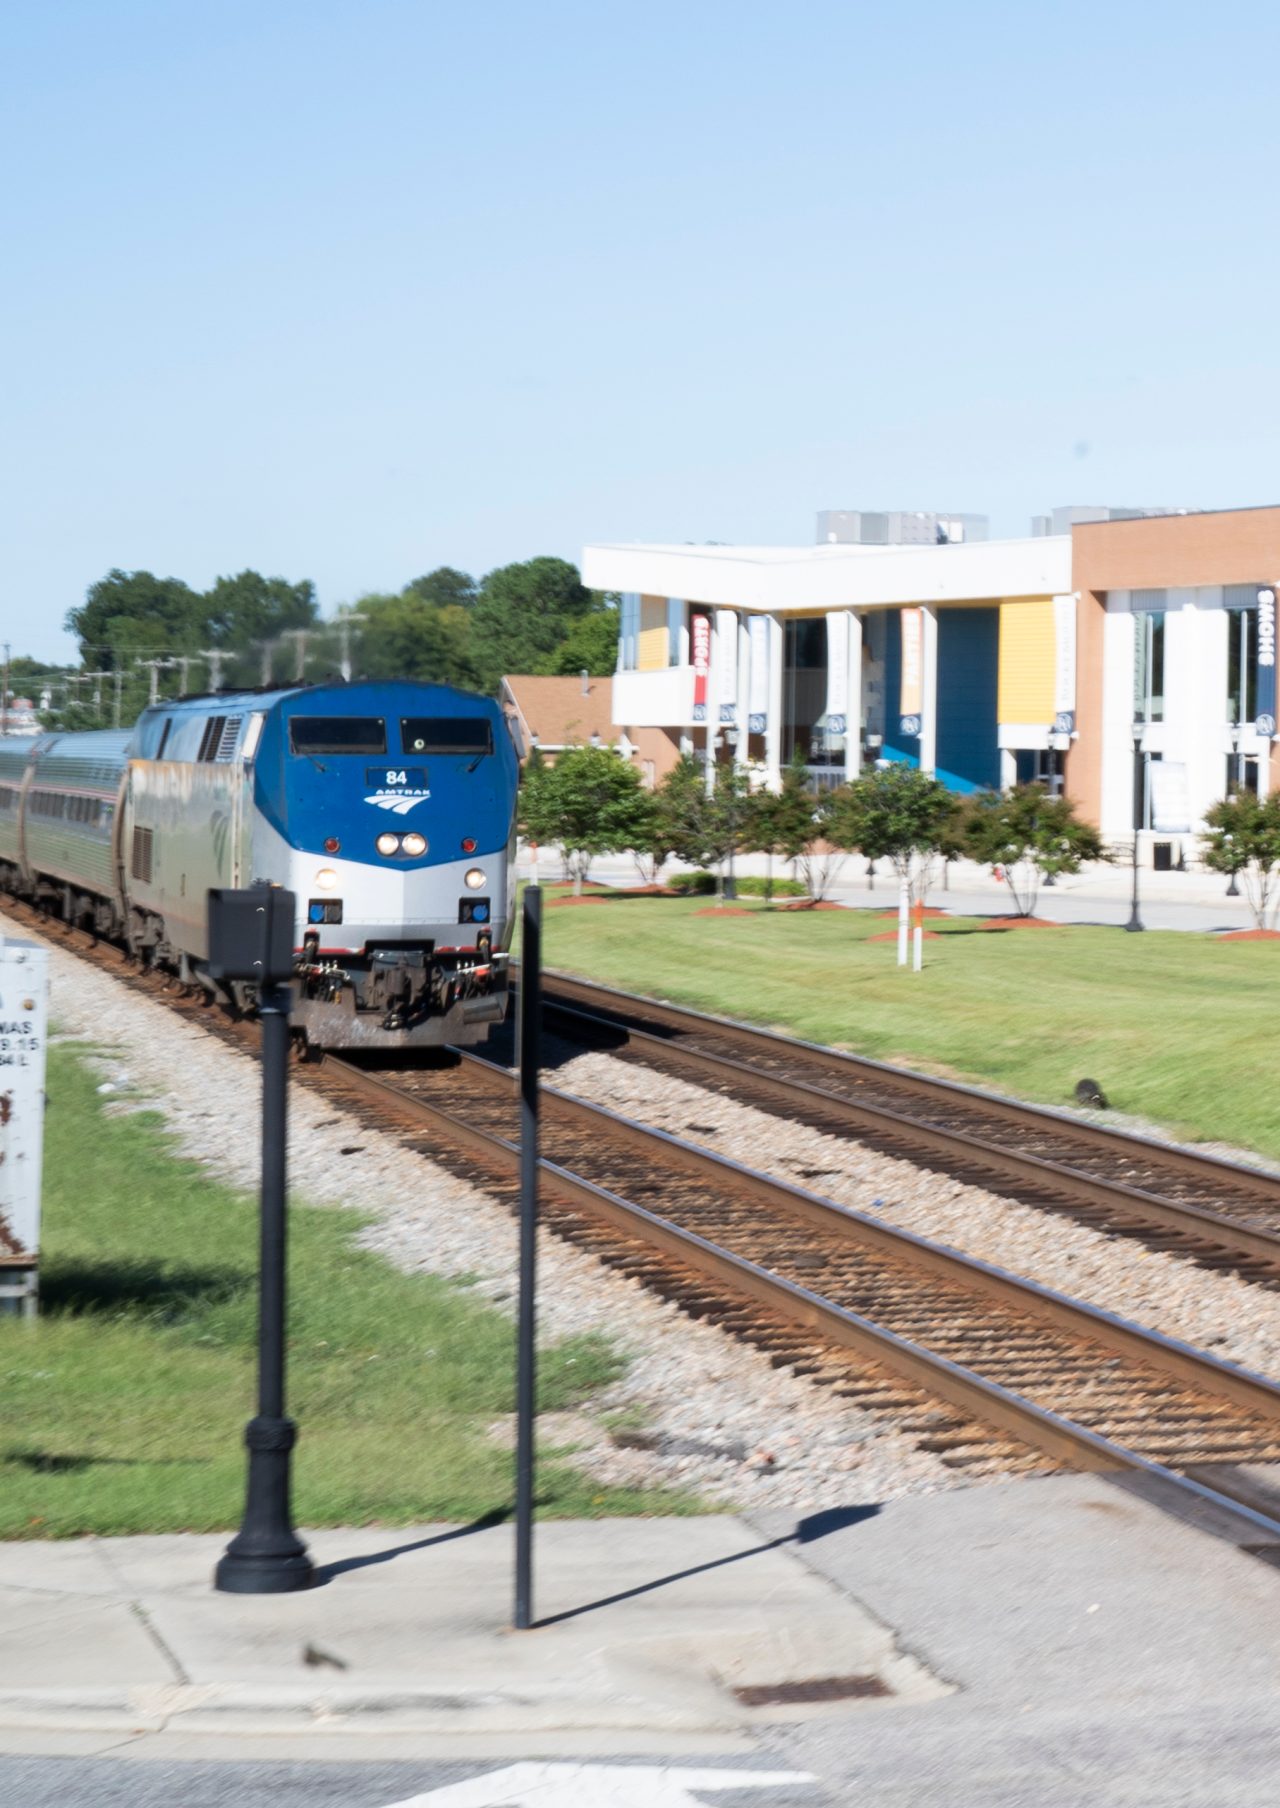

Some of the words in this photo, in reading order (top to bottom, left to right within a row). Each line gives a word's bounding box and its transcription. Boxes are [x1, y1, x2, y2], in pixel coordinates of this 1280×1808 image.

[693, 617, 710, 676] SPORTS
[1258, 590, 1275, 666] SHOWS
[386, 770, 408, 785] 84
